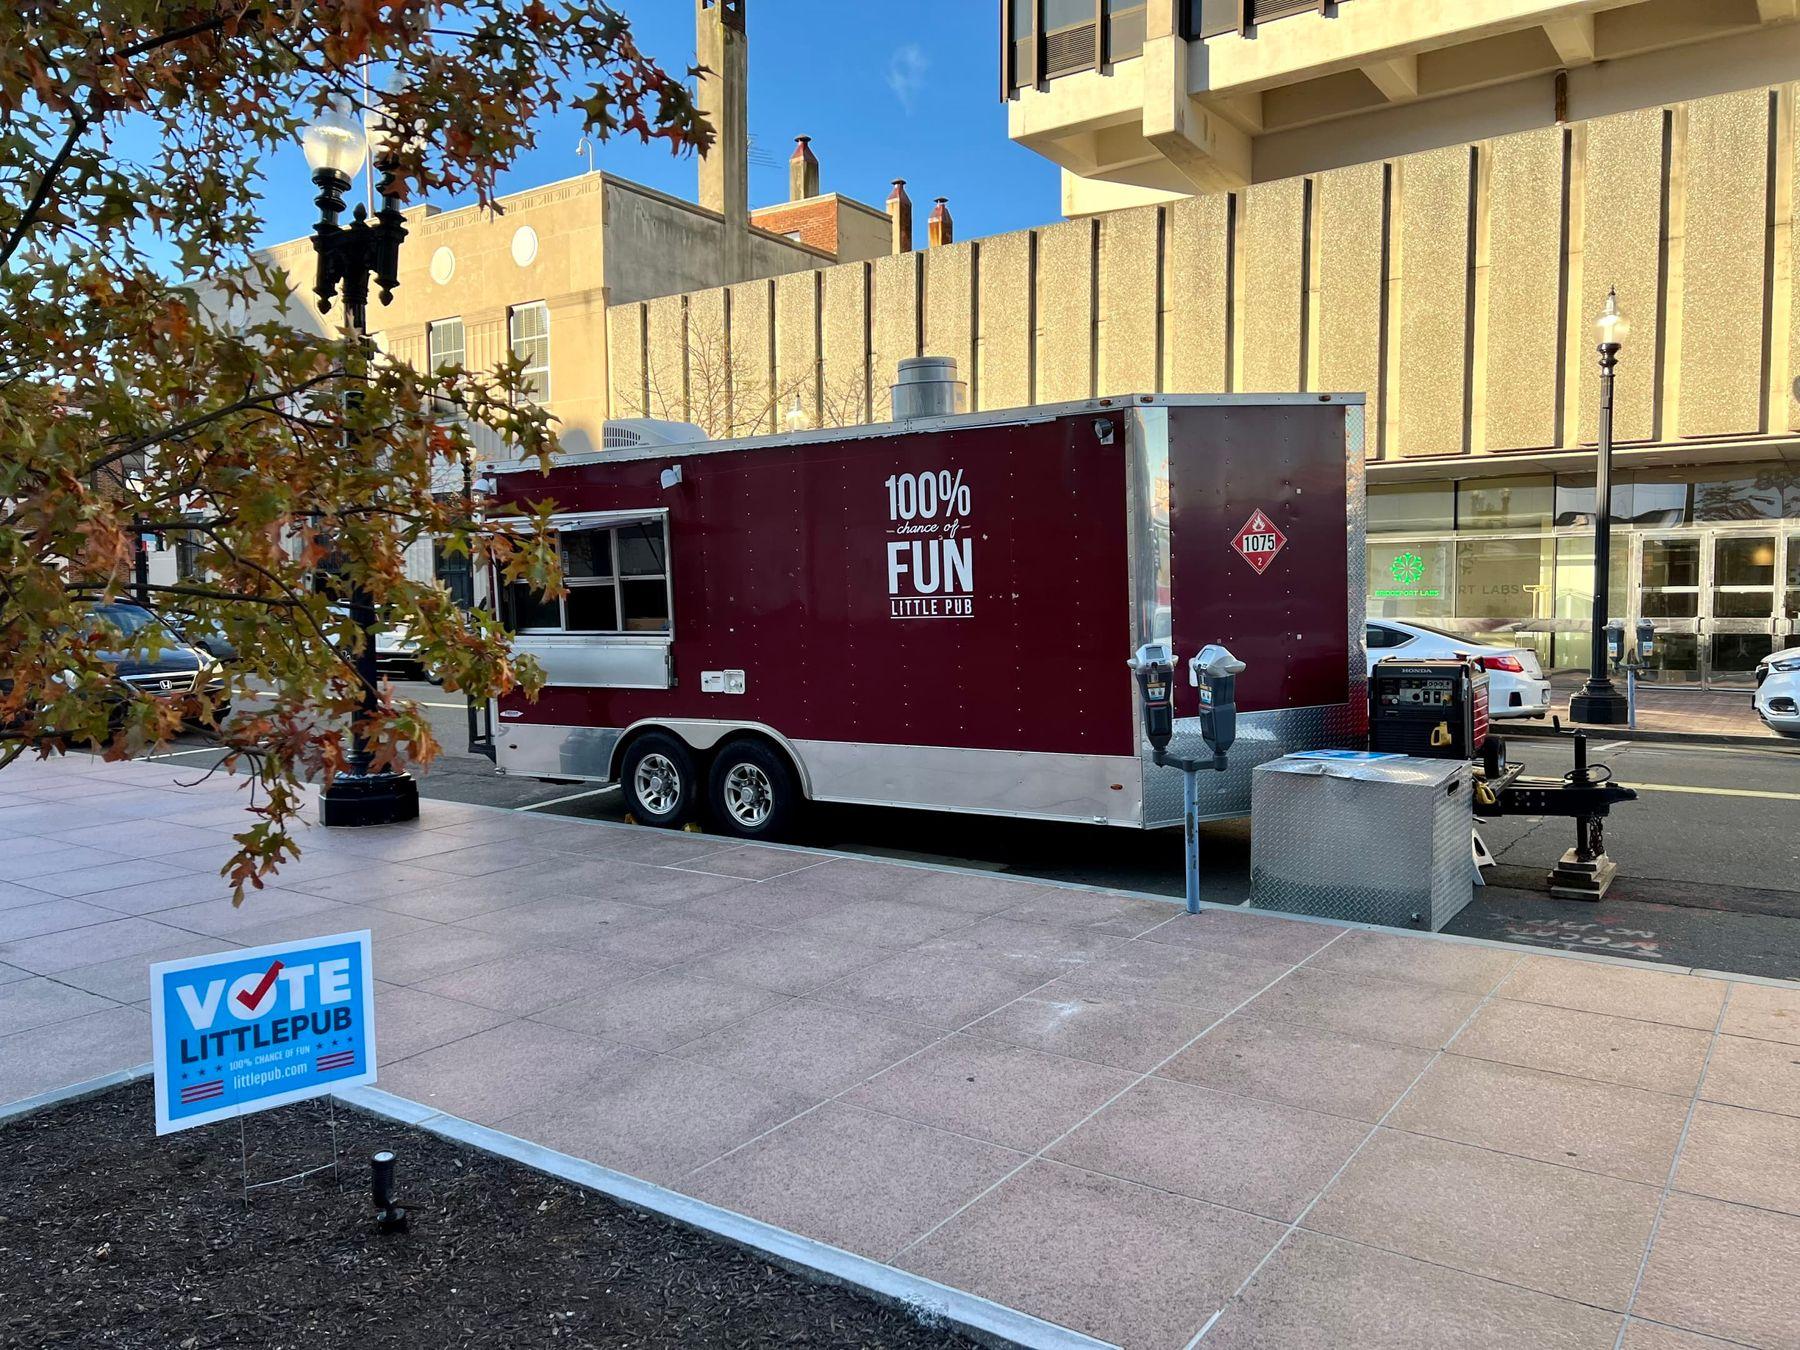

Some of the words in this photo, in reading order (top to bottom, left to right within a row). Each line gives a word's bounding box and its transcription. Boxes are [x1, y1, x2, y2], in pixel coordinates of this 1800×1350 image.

[885, 469, 971, 521] 100%
[896, 521, 939, 534] chance
[943, 518, 960, 539] of
[1244, 534, 1275, 552] 1075
[887, 538, 974, 594] FUN
[1257, 557, 1263, 566] 2
[1482, 584, 1520, 595] LABS
[891, 599, 938, 616] LITTLE
[945, 598, 972, 615] PUB
[176, 958, 352, 1031] VOTE
[181, 1006, 353, 1065] LITTLEPUB
[229, 1058, 253, 1071] 100%
[254, 1050, 283, 1065] CHANCE
[285, 1048, 294, 1058] OF
[296, 1044, 311, 1055] FUN
[233, 1063, 308, 1090] littlepub.com
